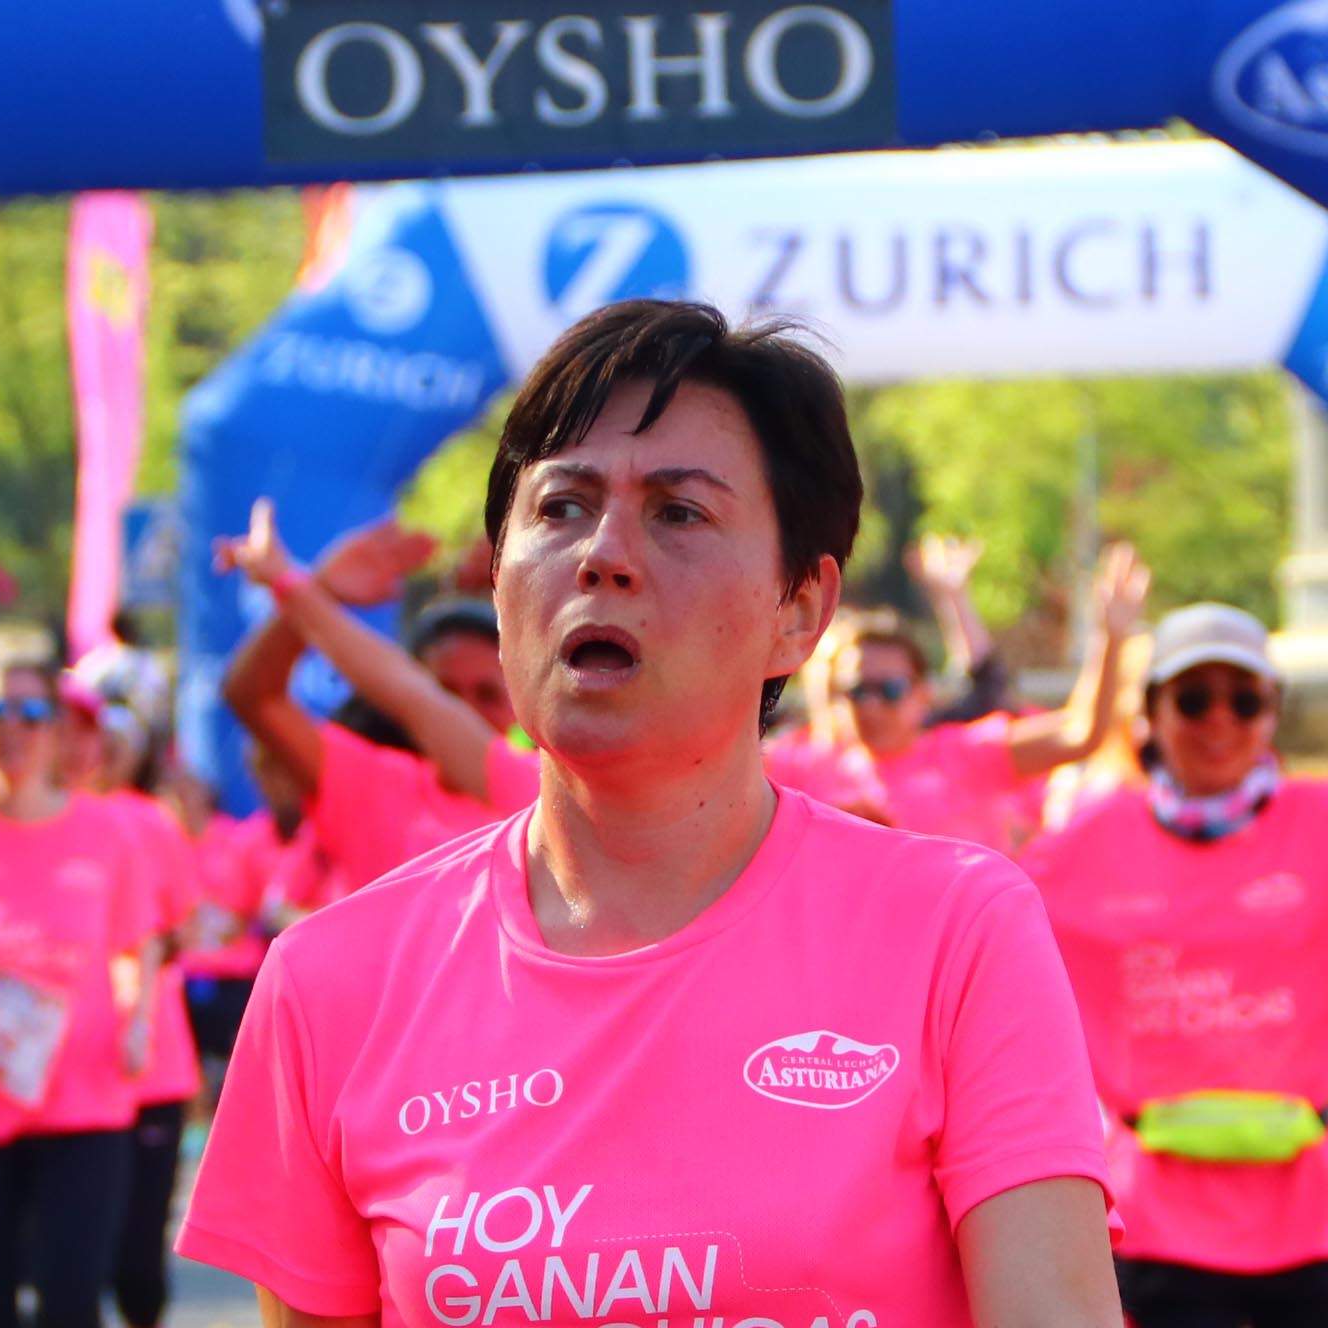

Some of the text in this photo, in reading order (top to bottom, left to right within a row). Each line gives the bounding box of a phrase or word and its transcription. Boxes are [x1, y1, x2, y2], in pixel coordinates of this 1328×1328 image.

[295, 4, 873, 135] OYSHO
[745, 216, 1214, 315] ZURICH
[398, 1069, 564, 1135] OYSHO
[757, 1056, 890, 1090] ASTURIANA
[424, 1185, 593, 1257] HOY
[425, 1245, 718, 1327] GANAN
